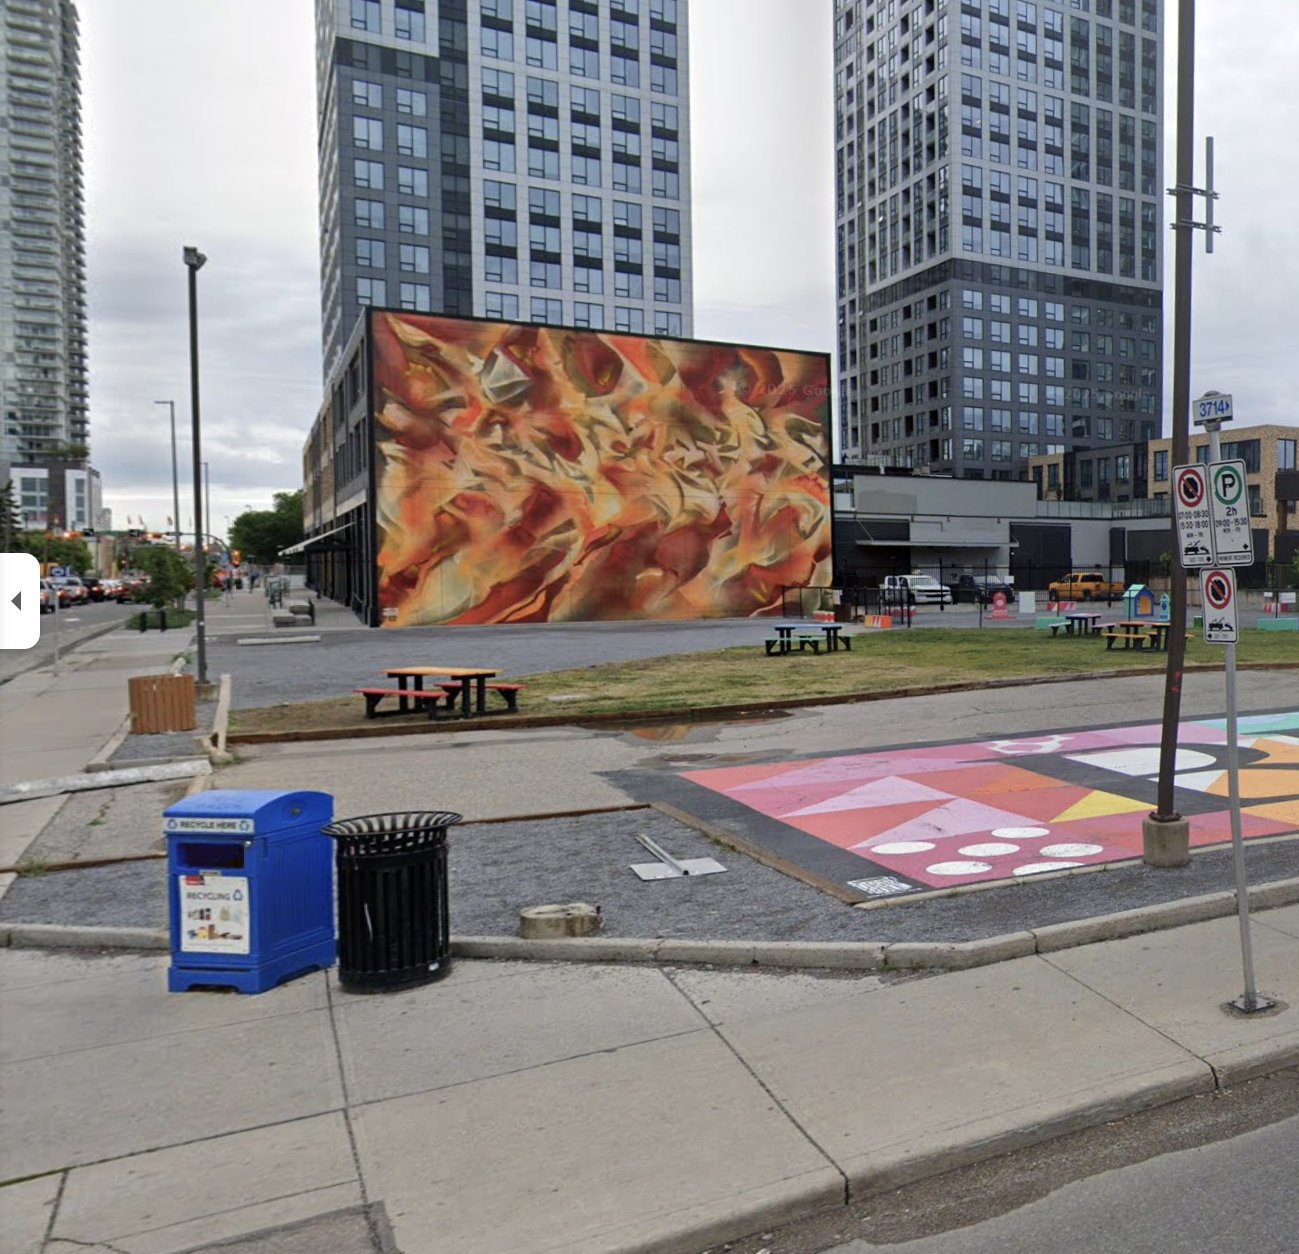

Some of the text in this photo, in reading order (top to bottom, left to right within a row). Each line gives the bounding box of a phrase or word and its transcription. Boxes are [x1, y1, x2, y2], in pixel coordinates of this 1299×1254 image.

[1199, 400, 1225, 417] 3714
[1221, 474, 1236, 498] P
[1225, 506, 1238, 517] 2h
[180, 820, 237, 830] RECYCLE HERE
[186, 891, 231, 901] RECYCLING
